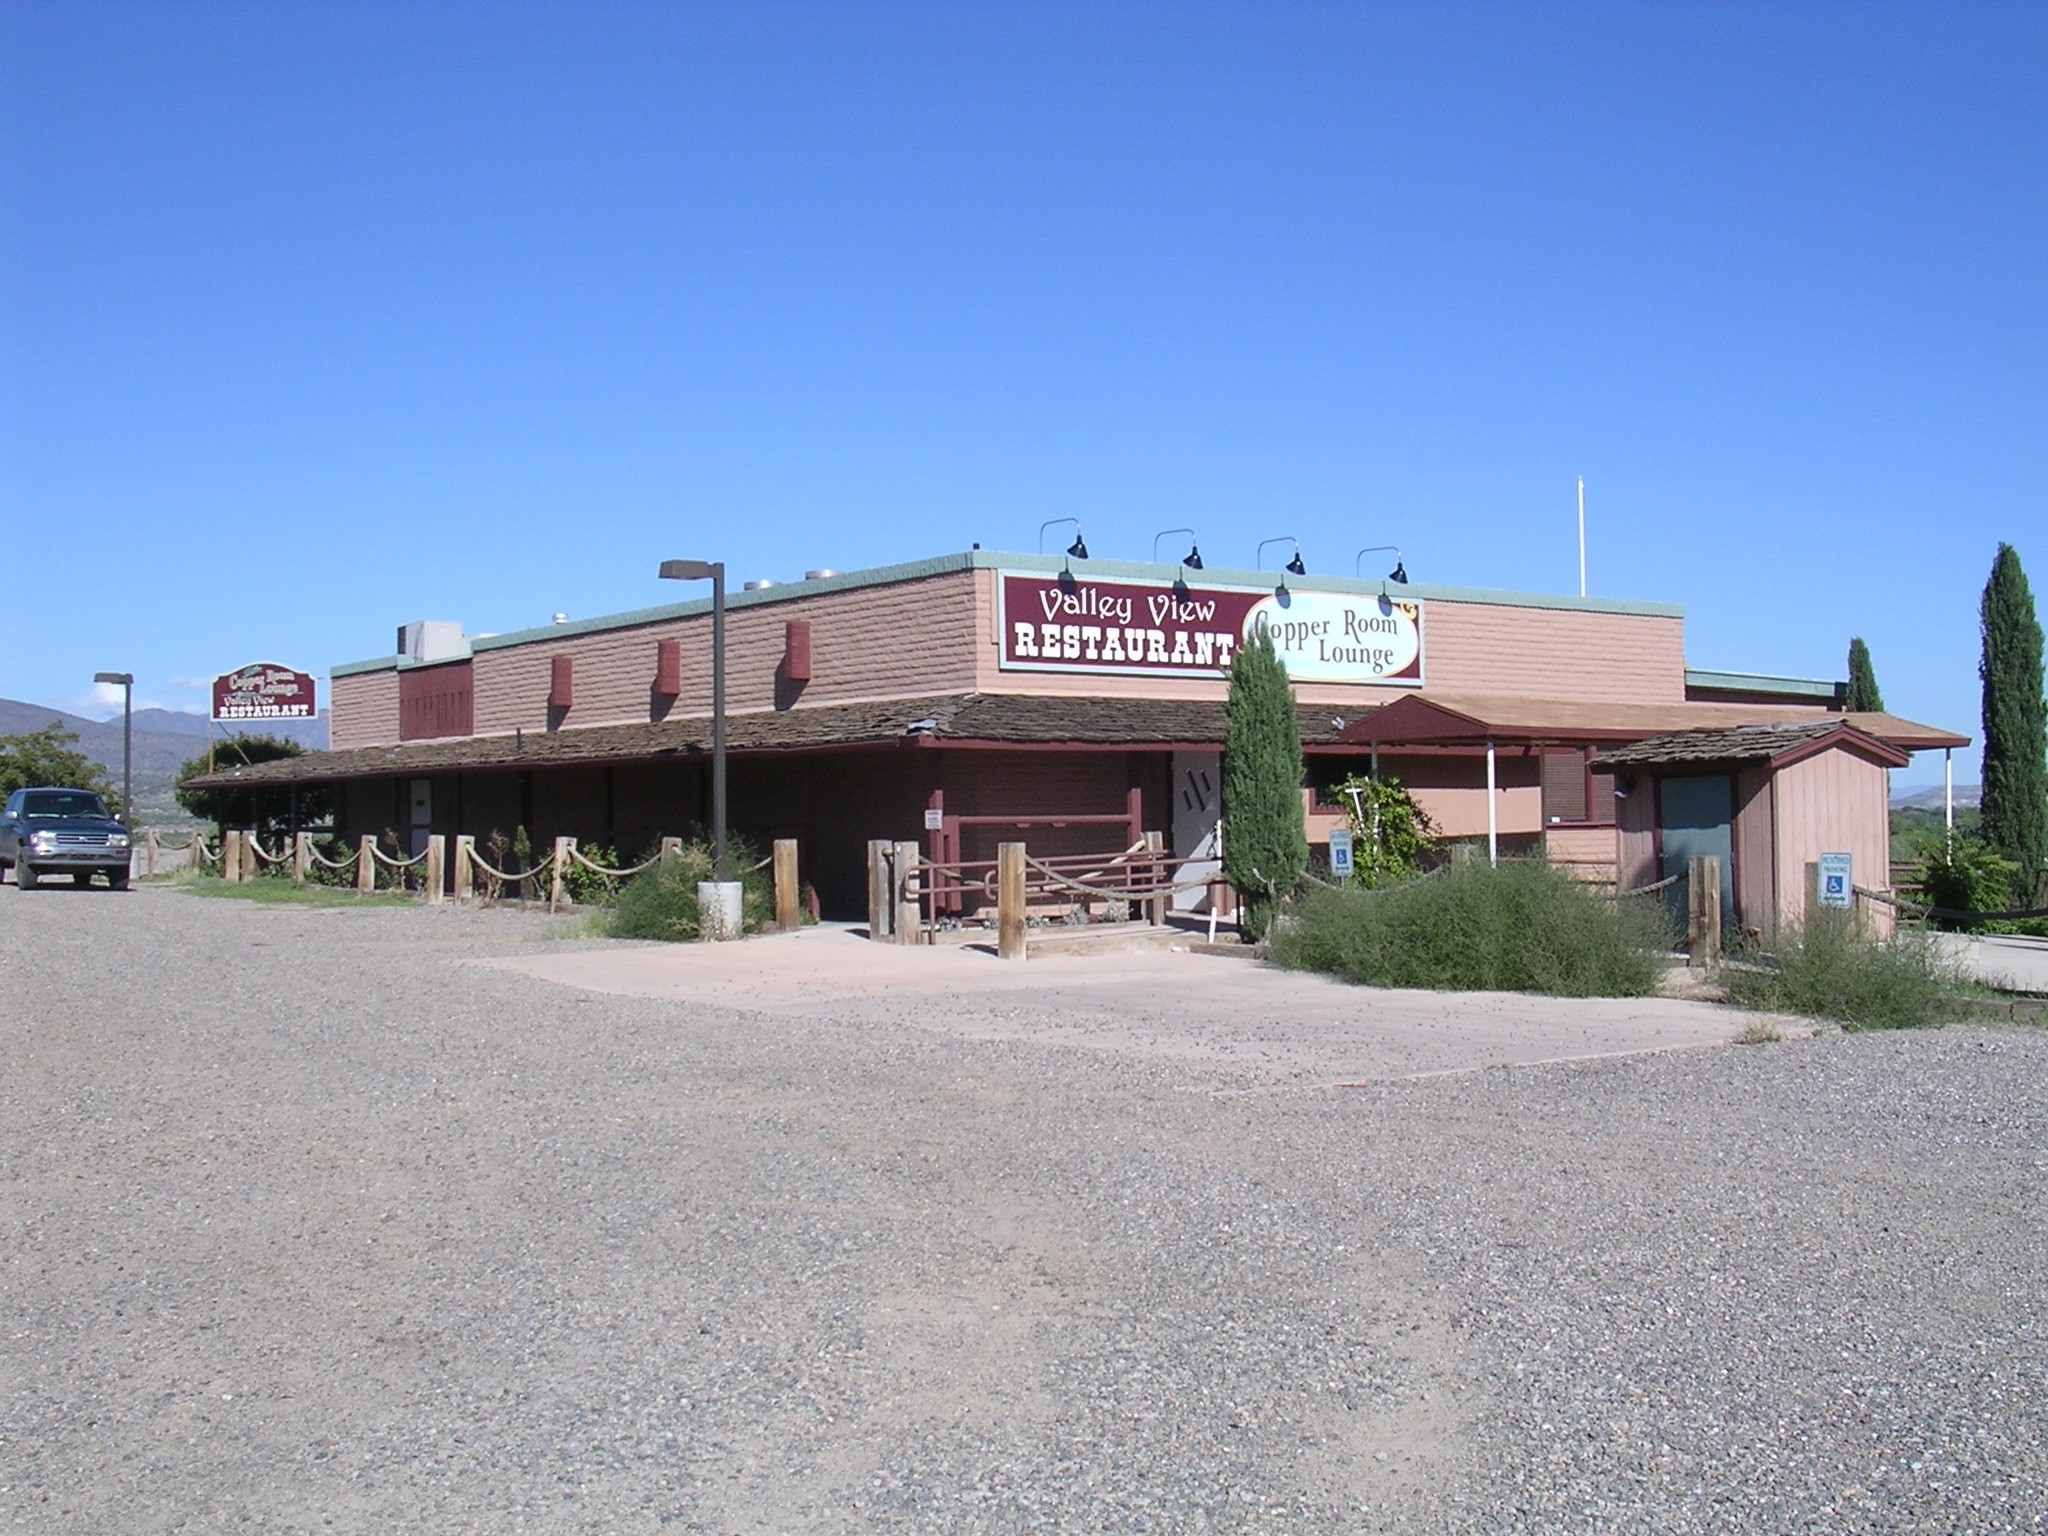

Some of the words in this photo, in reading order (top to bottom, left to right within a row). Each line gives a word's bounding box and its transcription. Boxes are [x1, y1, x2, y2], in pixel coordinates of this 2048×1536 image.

[1039, 587, 1132, 625] Valley
[1147, 594, 1216, 627] View
[1014, 621, 1234, 666] RESTAURANT
[1254, 610, 1330, 651] Copper
[1343, 609, 1398, 644] Room
[1319, 638, 1395, 674] Lounge
[229, 673, 265, 691] Copper
[219, 704, 309, 718] RESTAURANT
[223, 696, 252, 706] Valley
[252, 695, 275, 705] View
